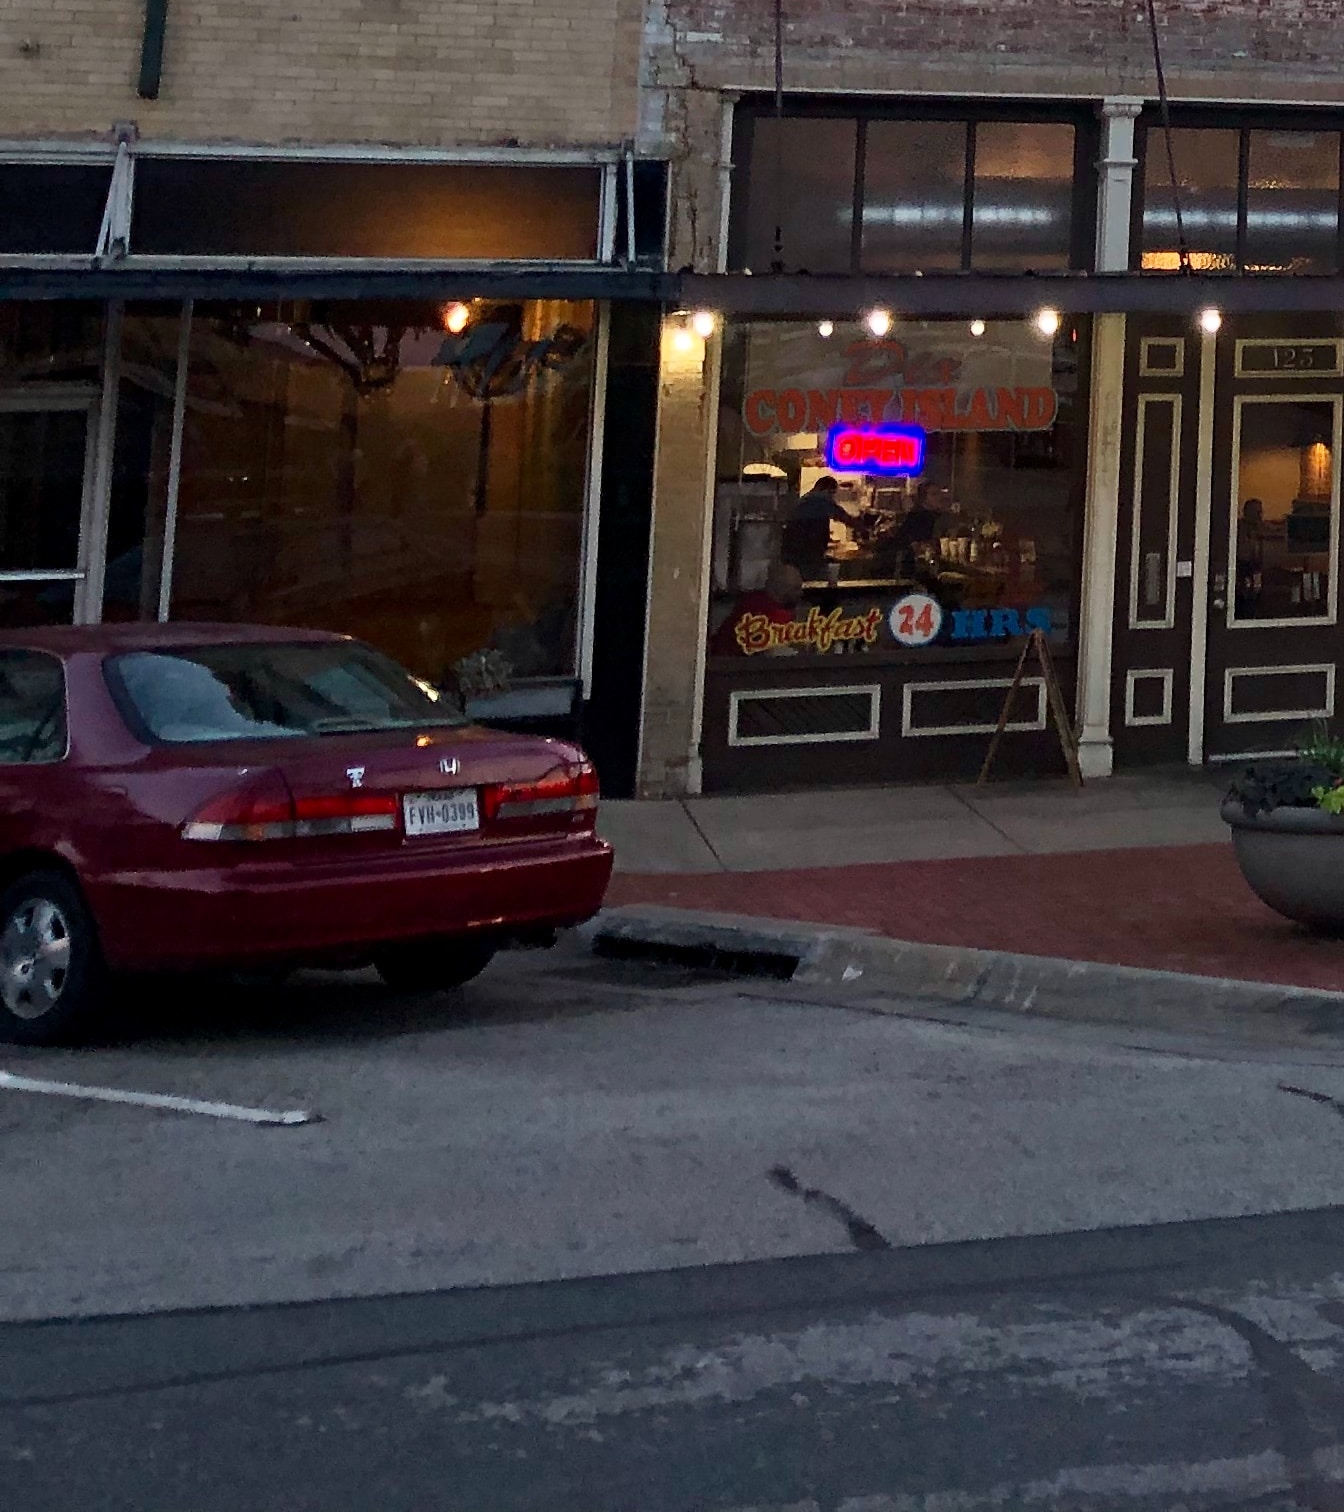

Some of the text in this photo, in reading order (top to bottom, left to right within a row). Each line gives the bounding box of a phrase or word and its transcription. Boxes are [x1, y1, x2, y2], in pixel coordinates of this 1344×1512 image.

[900, 387, 1057, 431] ISLAND
[837, 434, 918, 466] OPEN
[735, 603, 1051, 655] Breakfast 24 HRS
